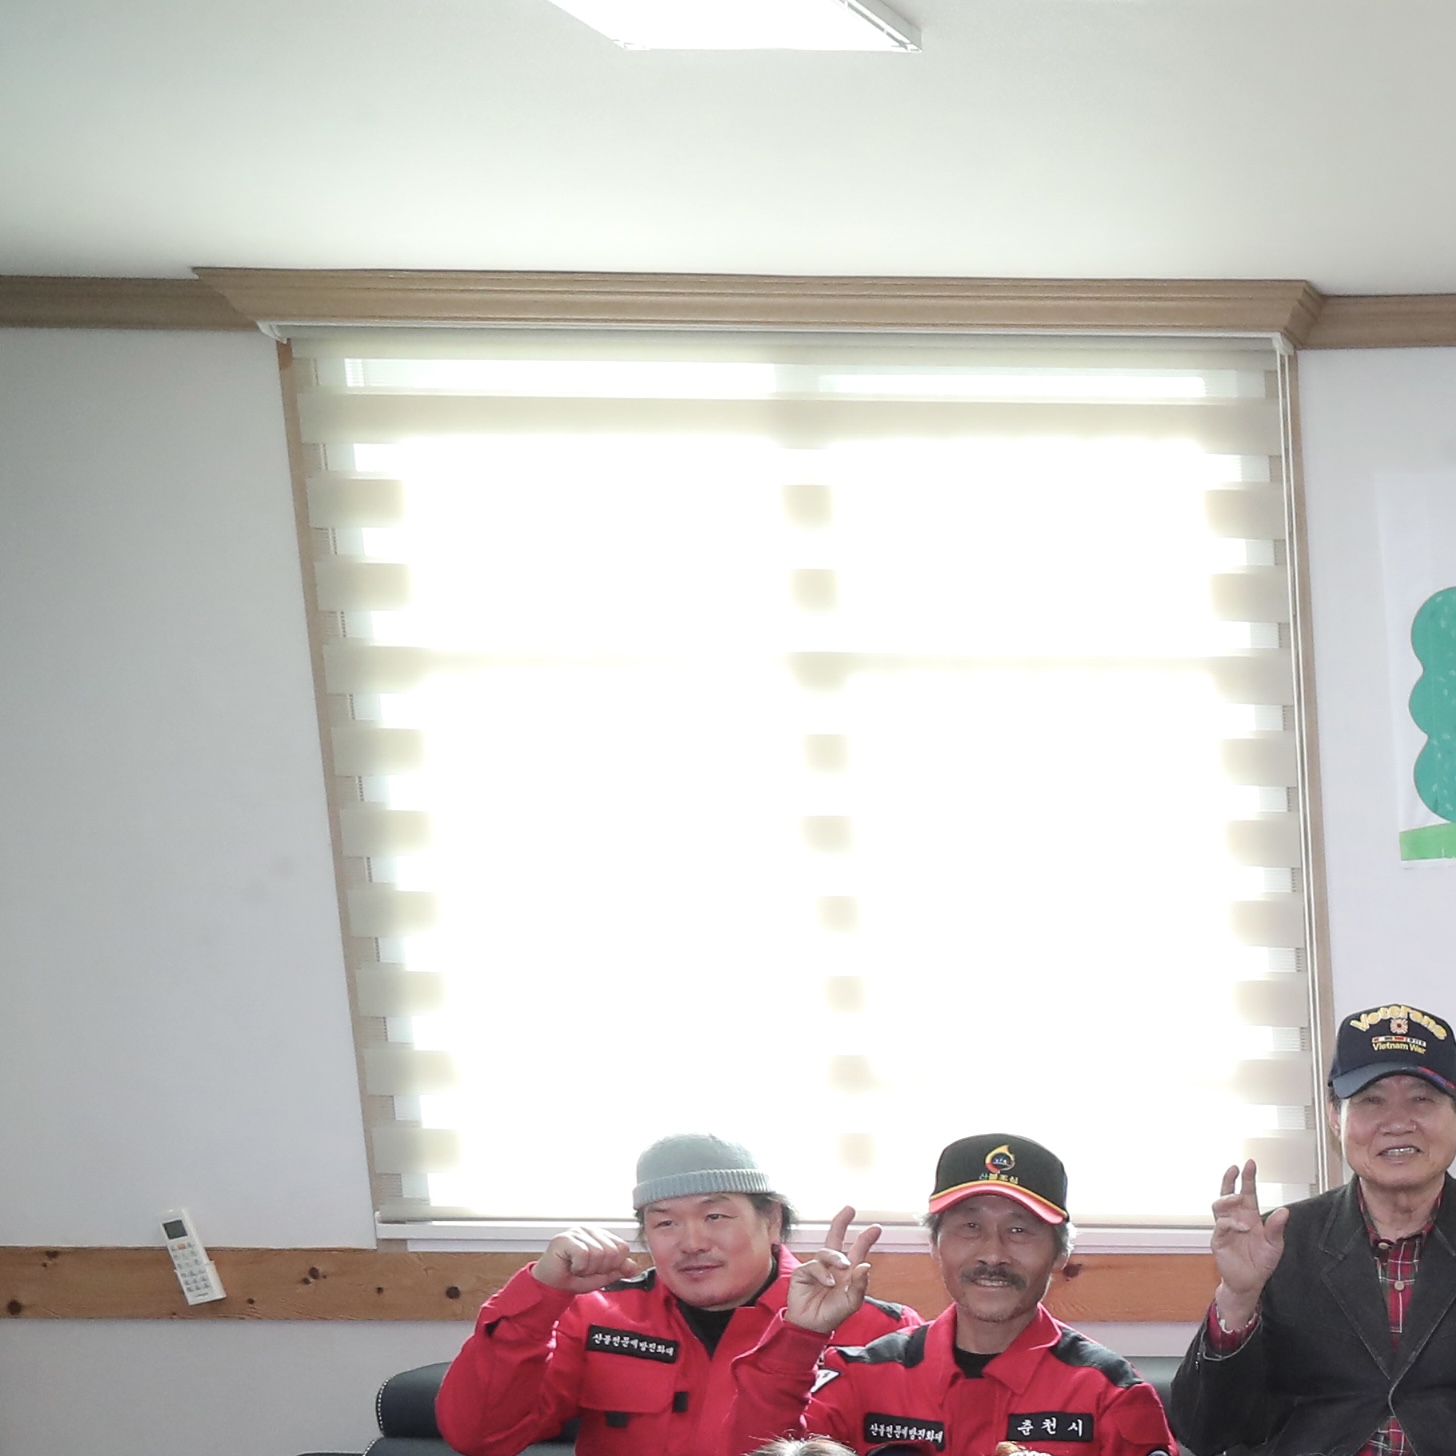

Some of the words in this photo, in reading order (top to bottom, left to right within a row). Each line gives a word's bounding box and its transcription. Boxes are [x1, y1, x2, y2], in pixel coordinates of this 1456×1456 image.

[1372, 1042, 1408, 1051] Vietnam
[1409, 1044, 1426, 1054] War
[1016, 1418, 1084, 1437] 춘천시
